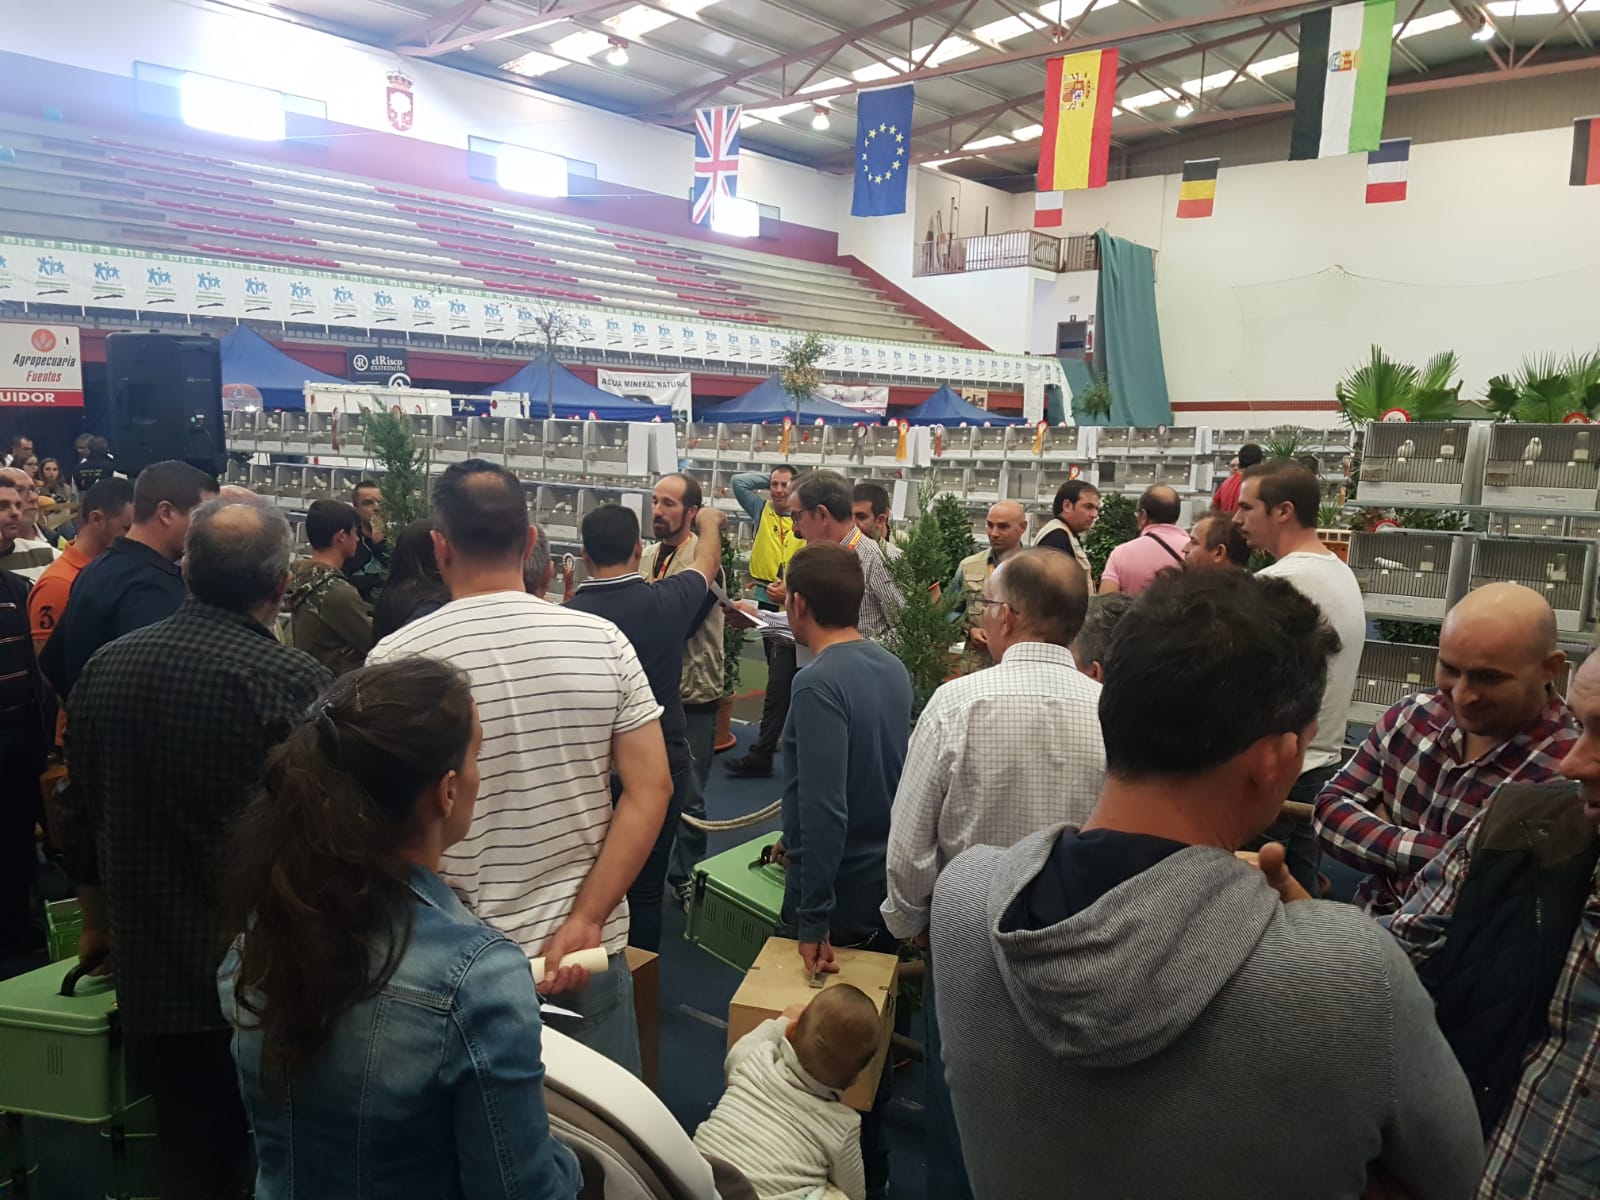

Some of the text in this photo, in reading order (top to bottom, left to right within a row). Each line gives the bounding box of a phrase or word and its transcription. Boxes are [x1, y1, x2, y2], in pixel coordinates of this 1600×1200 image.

[13, 353, 76, 368] Agropecuaria
[26, 370, 62, 382] Fuentes
[624, 380, 656, 388] MINERAL
[0, 391, 56, 403] UIDOR
[39, 605, 55, 630] 3
